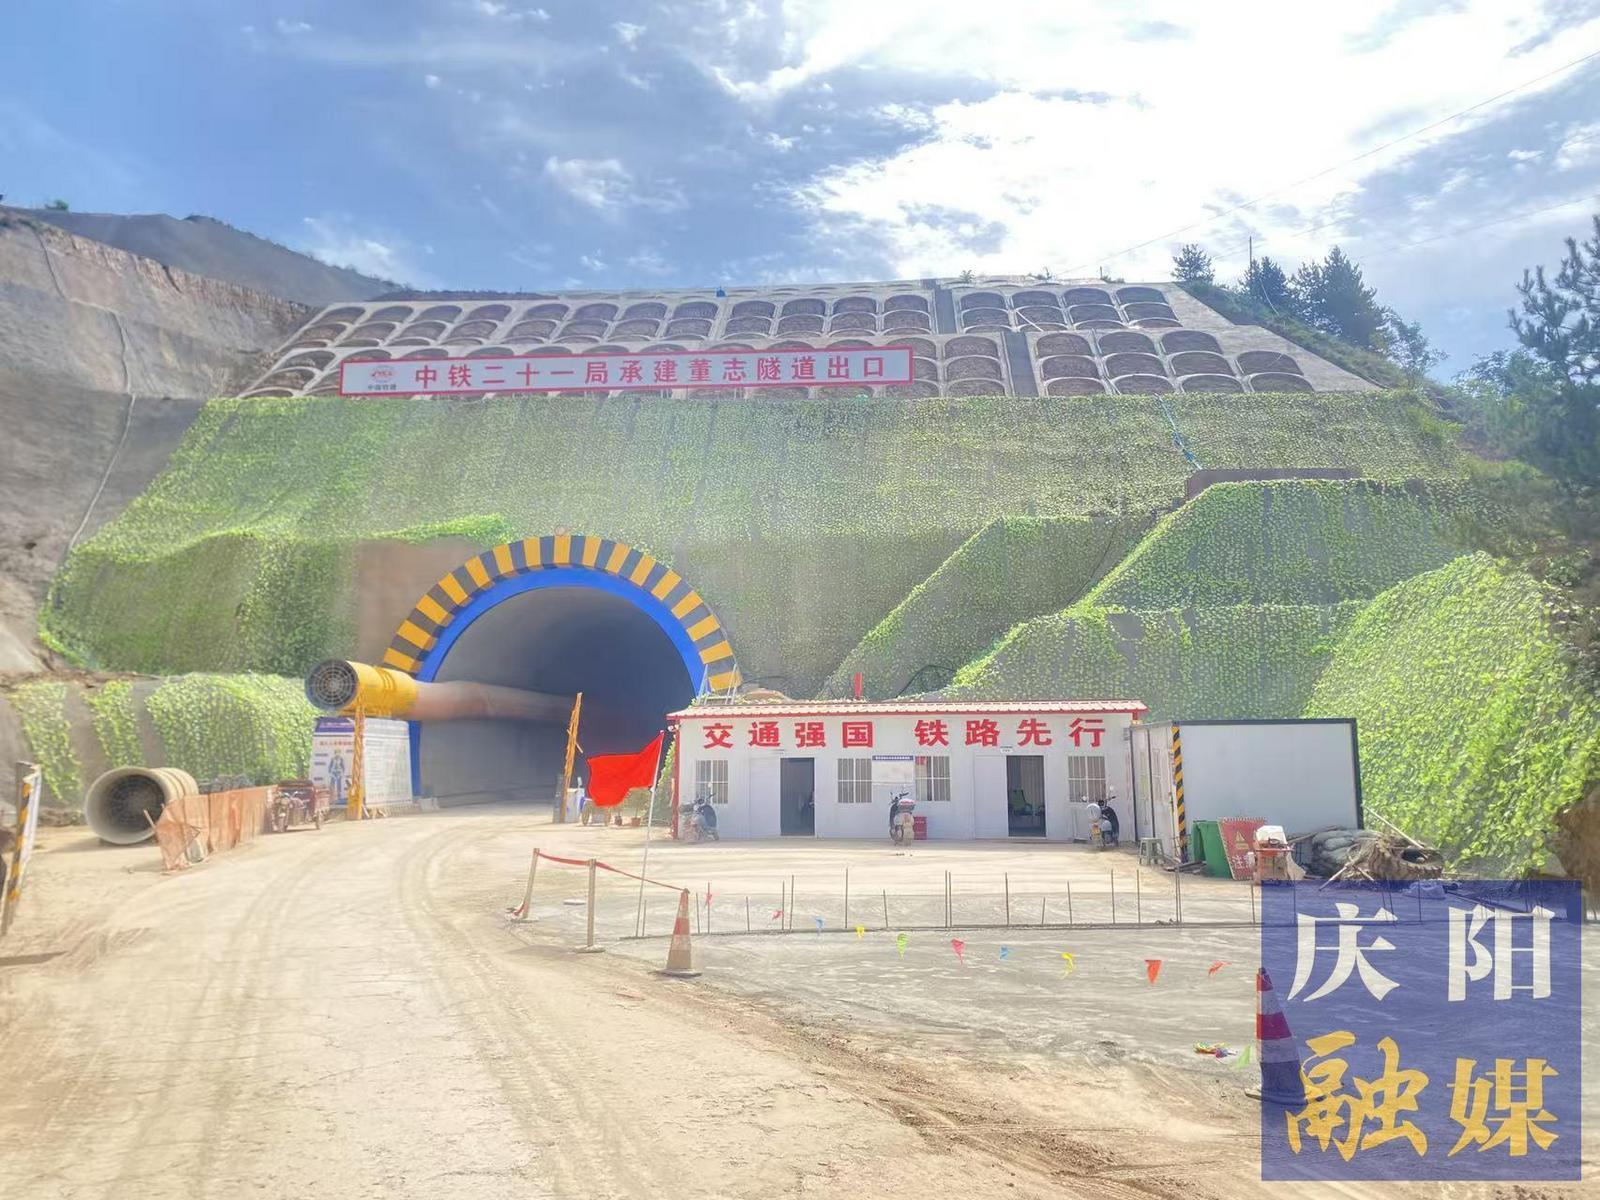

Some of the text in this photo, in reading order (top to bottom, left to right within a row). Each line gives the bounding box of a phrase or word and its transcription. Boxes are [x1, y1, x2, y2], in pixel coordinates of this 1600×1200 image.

[415, 356, 886, 388] 中铁二十一局承建董志隧道出口
[703, 719, 1106, 749] 交通强国 铁路先行
